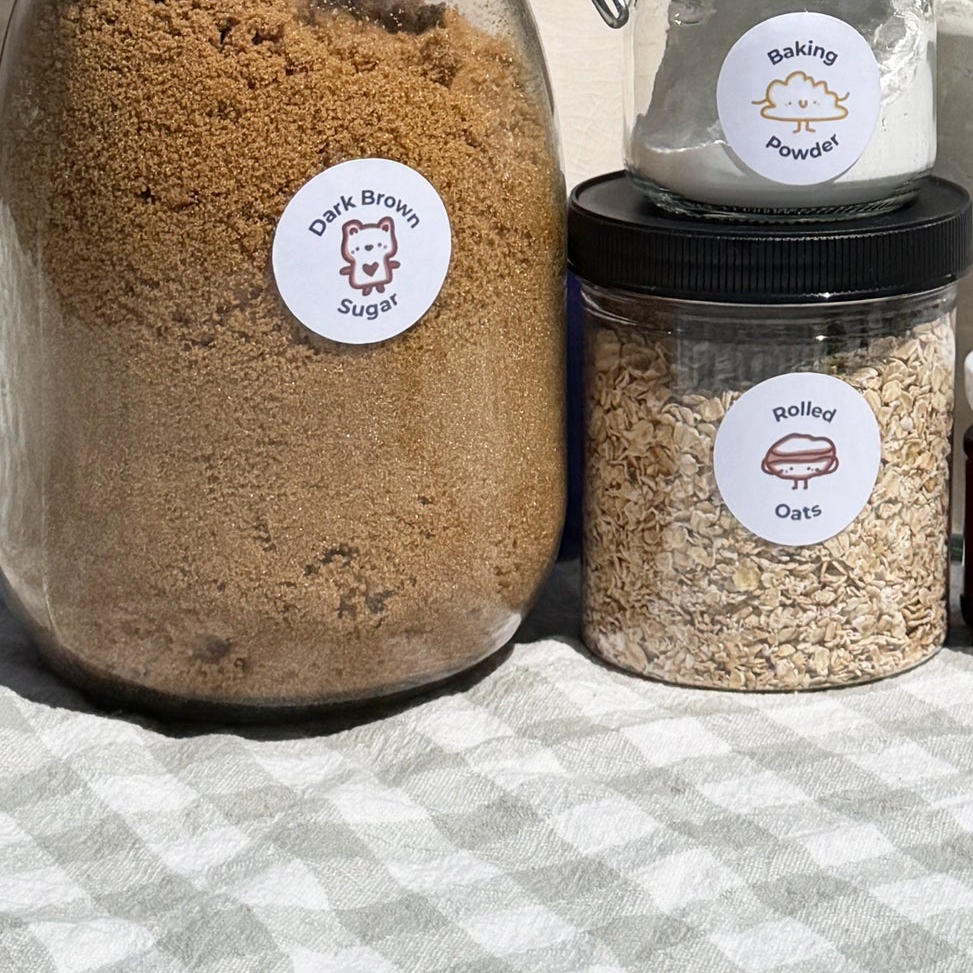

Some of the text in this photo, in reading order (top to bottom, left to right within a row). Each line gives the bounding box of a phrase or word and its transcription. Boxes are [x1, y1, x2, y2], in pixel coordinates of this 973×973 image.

[766, 40, 839, 67] Baking
[765, 133, 839, 161] Powder
[308, 189, 420, 237] Dark Brown
[337, 292, 398, 321] Sugar
[772, 400, 837, 423] Rolled
[774, 503, 822, 521] Oats
